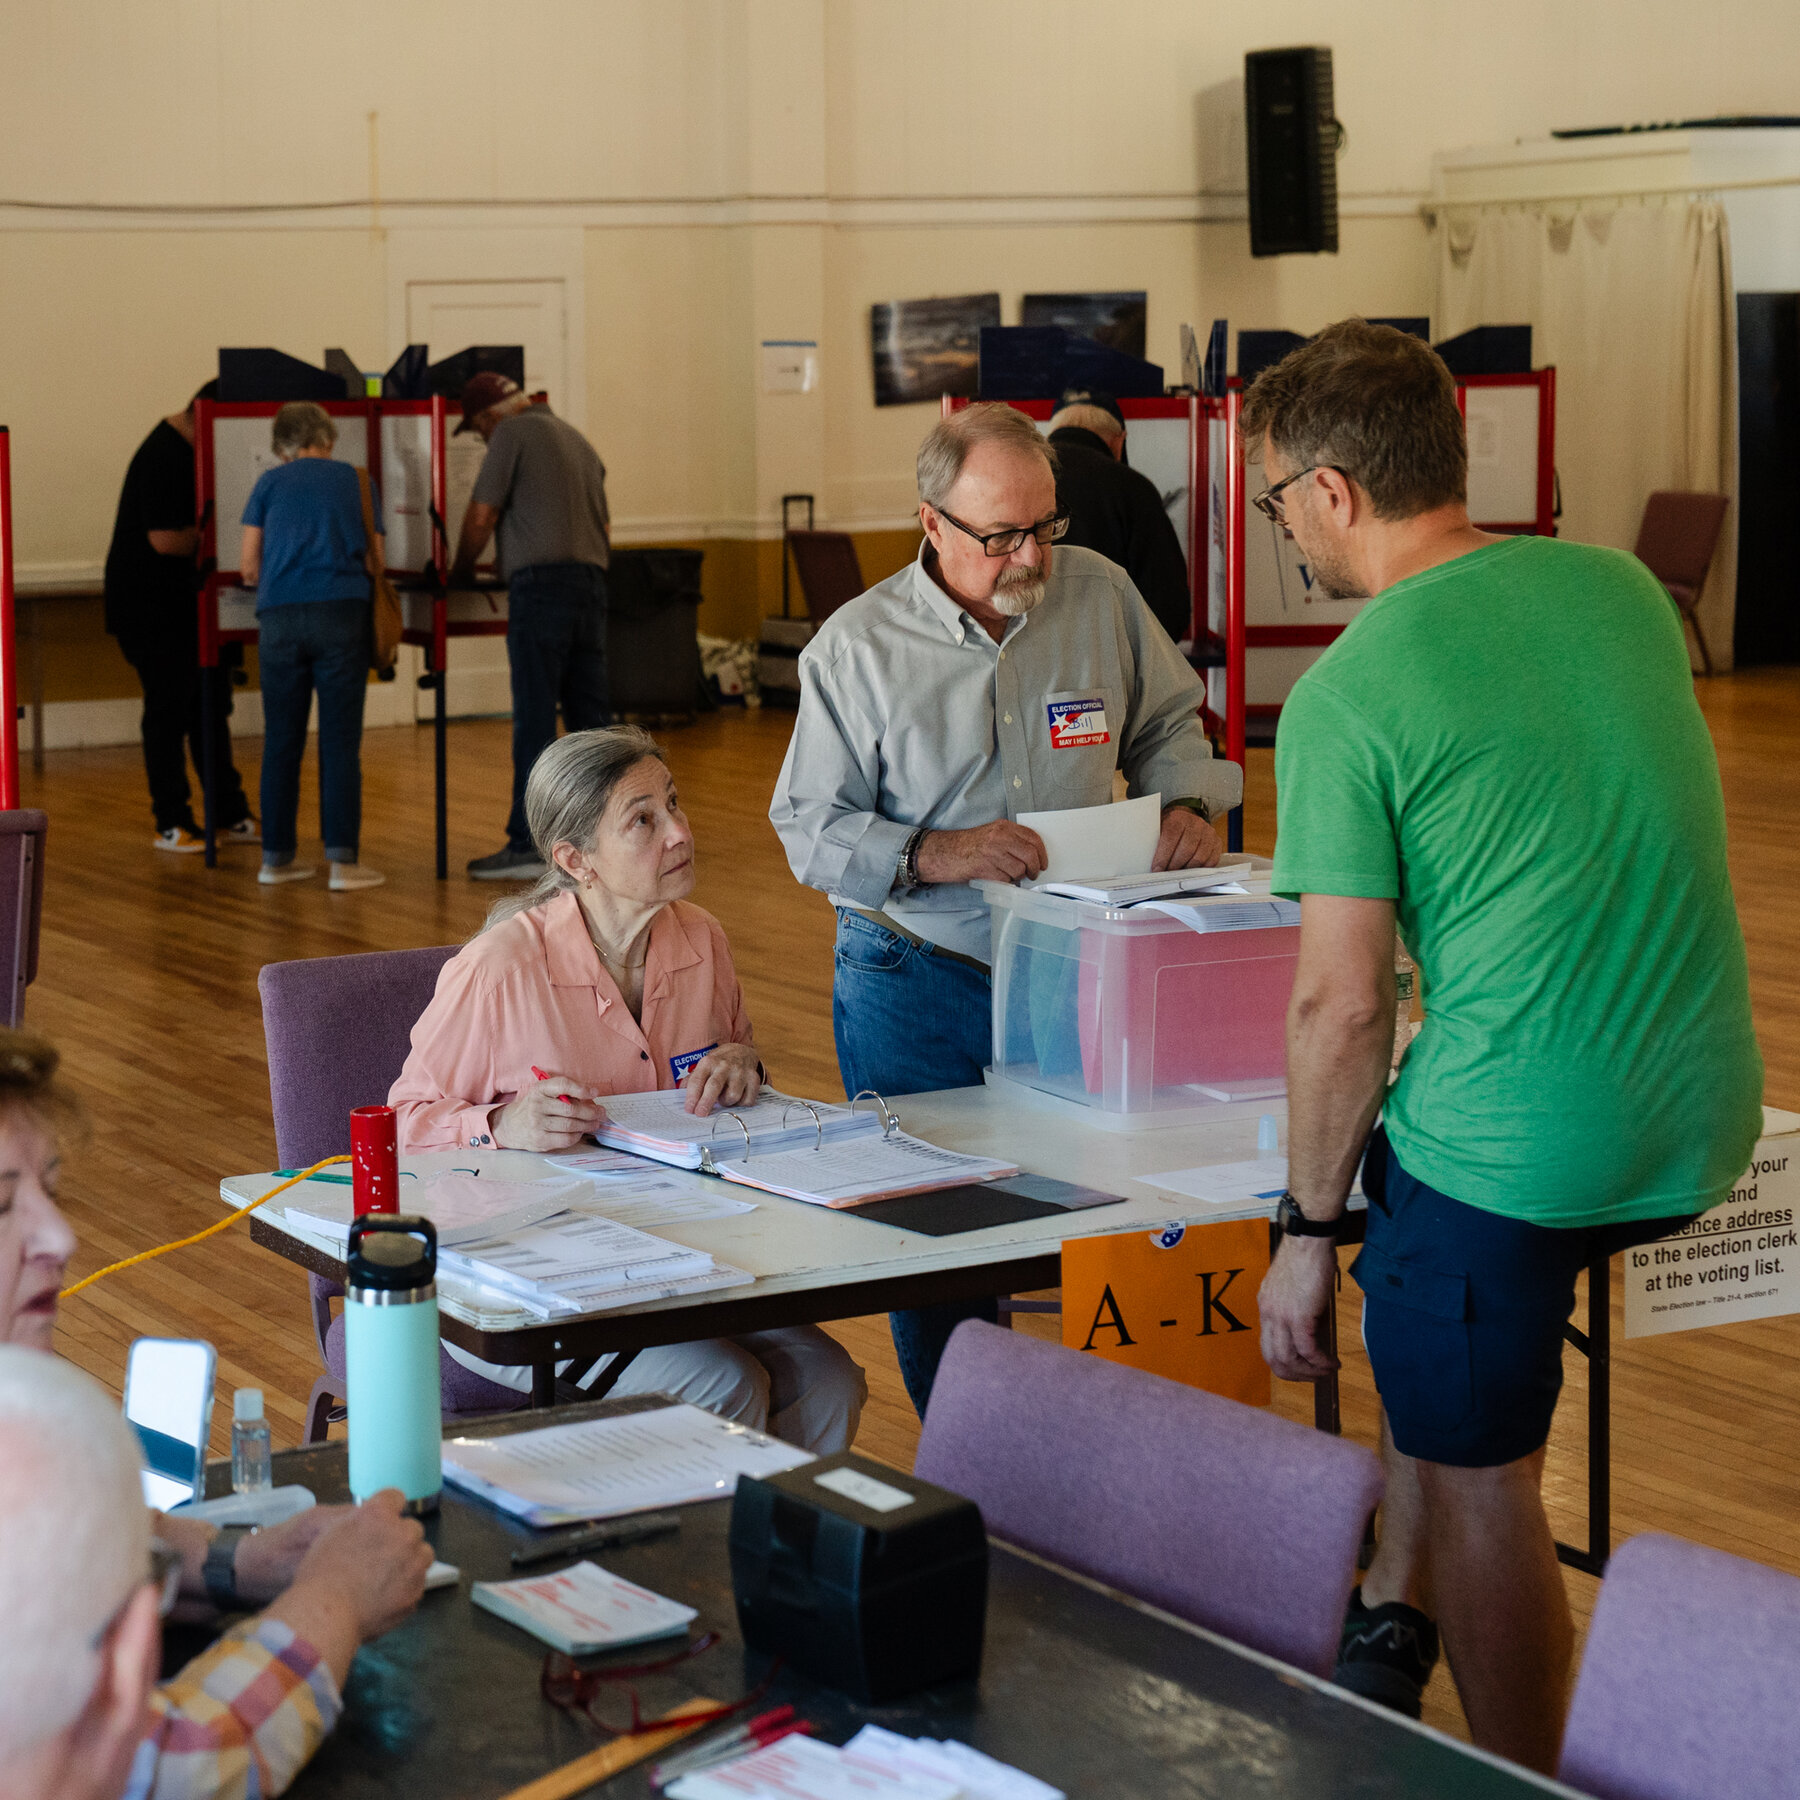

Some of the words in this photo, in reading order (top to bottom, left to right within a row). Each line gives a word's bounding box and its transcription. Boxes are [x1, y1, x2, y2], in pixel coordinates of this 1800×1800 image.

[1051, 703, 1082, 713] ELECTION
[1082, 701, 1103, 711] OFFICIAL
[1068, 716, 1093, 731] Bill
[1058, 738, 1073, 746] MAY
[1076, 736, 1092, 744] HELP
[674, 1052, 703, 1066] ELECTION
[1751, 1157, 1789, 1179] your
[1727, 1184, 1758, 1203] and
[1726, 1208, 1793, 1229] address
[1632, 1251, 1649, 1268] to
[1655, 1246, 1681, 1265] the
[1687, 1237, 1752, 1260] election
[1757, 1230, 1797, 1250] clerk
[1645, 1275, 1662, 1292] at
[1667, 1271, 1693, 1290] the
[1698, 1263, 1749, 1284] voting
[1755, 1258, 1784, 1276] list.
[1080, 1283, 1138, 1351] A
[1160, 1319, 1177, 1327] -
[1195, 1268, 1252, 1337] K
[1650, 1305, 1668, 1313] State
[1669, 1301, 1694, 1311] Election
[1744, 1290, 1767, 1299] section
